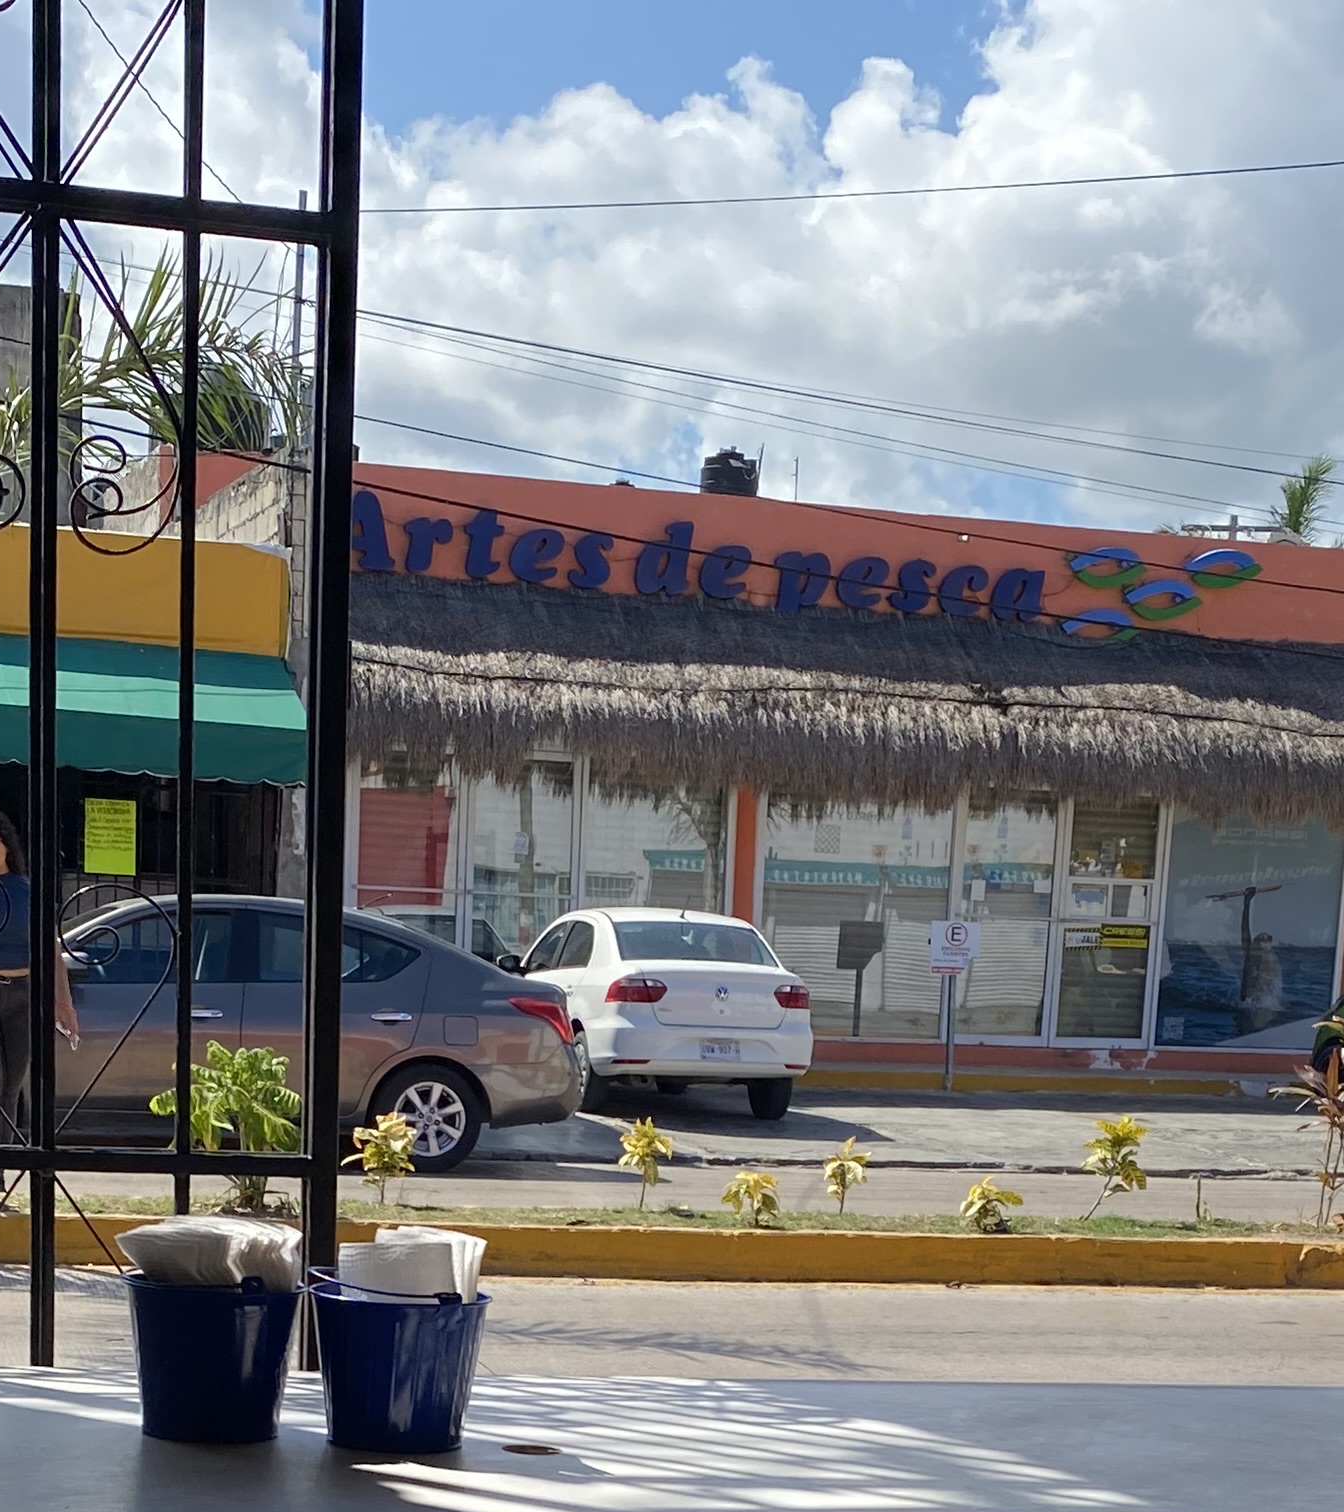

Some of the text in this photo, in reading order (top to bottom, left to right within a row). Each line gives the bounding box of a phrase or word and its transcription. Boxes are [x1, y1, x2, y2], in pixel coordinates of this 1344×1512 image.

[352, 490, 1048, 623] Artes de pesca
[951, 926, 962, 942] E
